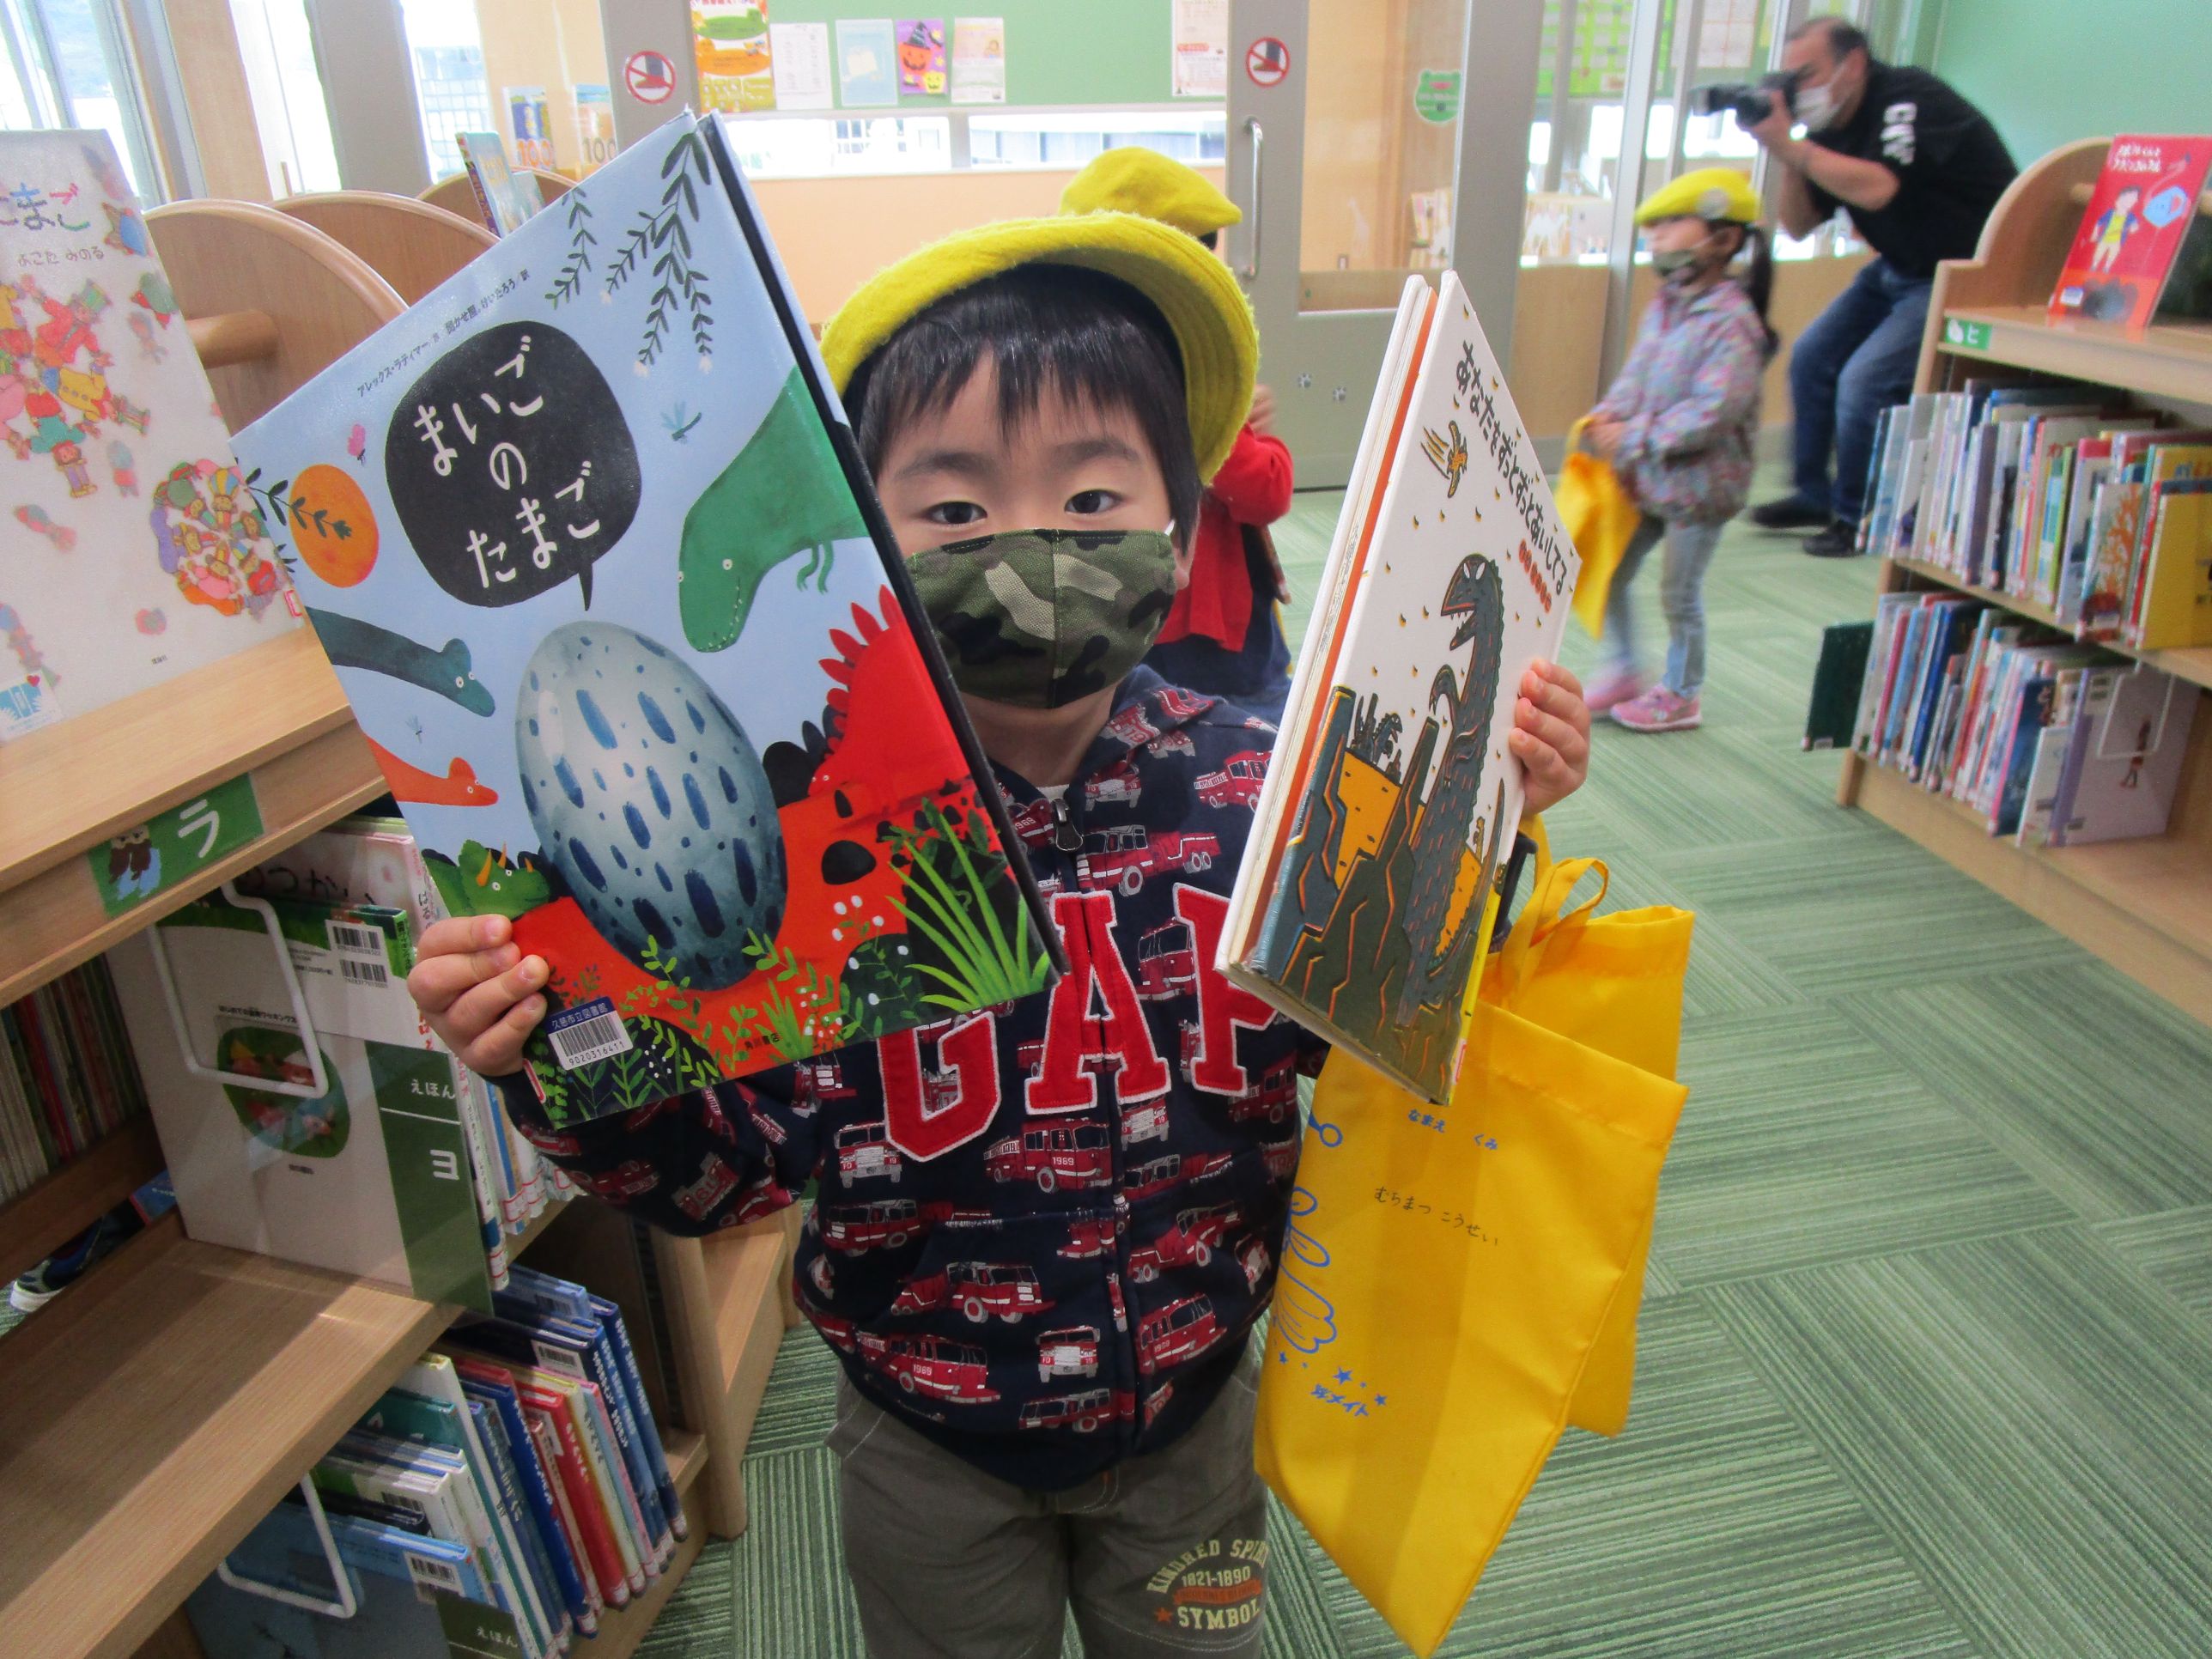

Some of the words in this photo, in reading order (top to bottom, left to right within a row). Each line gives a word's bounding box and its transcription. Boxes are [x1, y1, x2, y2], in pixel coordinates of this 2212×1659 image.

[414, 334, 544, 477] まいご
[489, 441, 528, 490] の
[466, 460, 600, 588] たまご
[178, 799, 220, 858] ラ
[568, 1041, 625, 1066] 9020316411
[410, 1079, 455, 1100] えほん
[1052, 1156, 1074, 1166] 1969
[1182, 1565, 1251, 1588] 1821-1890
[1177, 1598, 1261, 1630] SYMBOL
